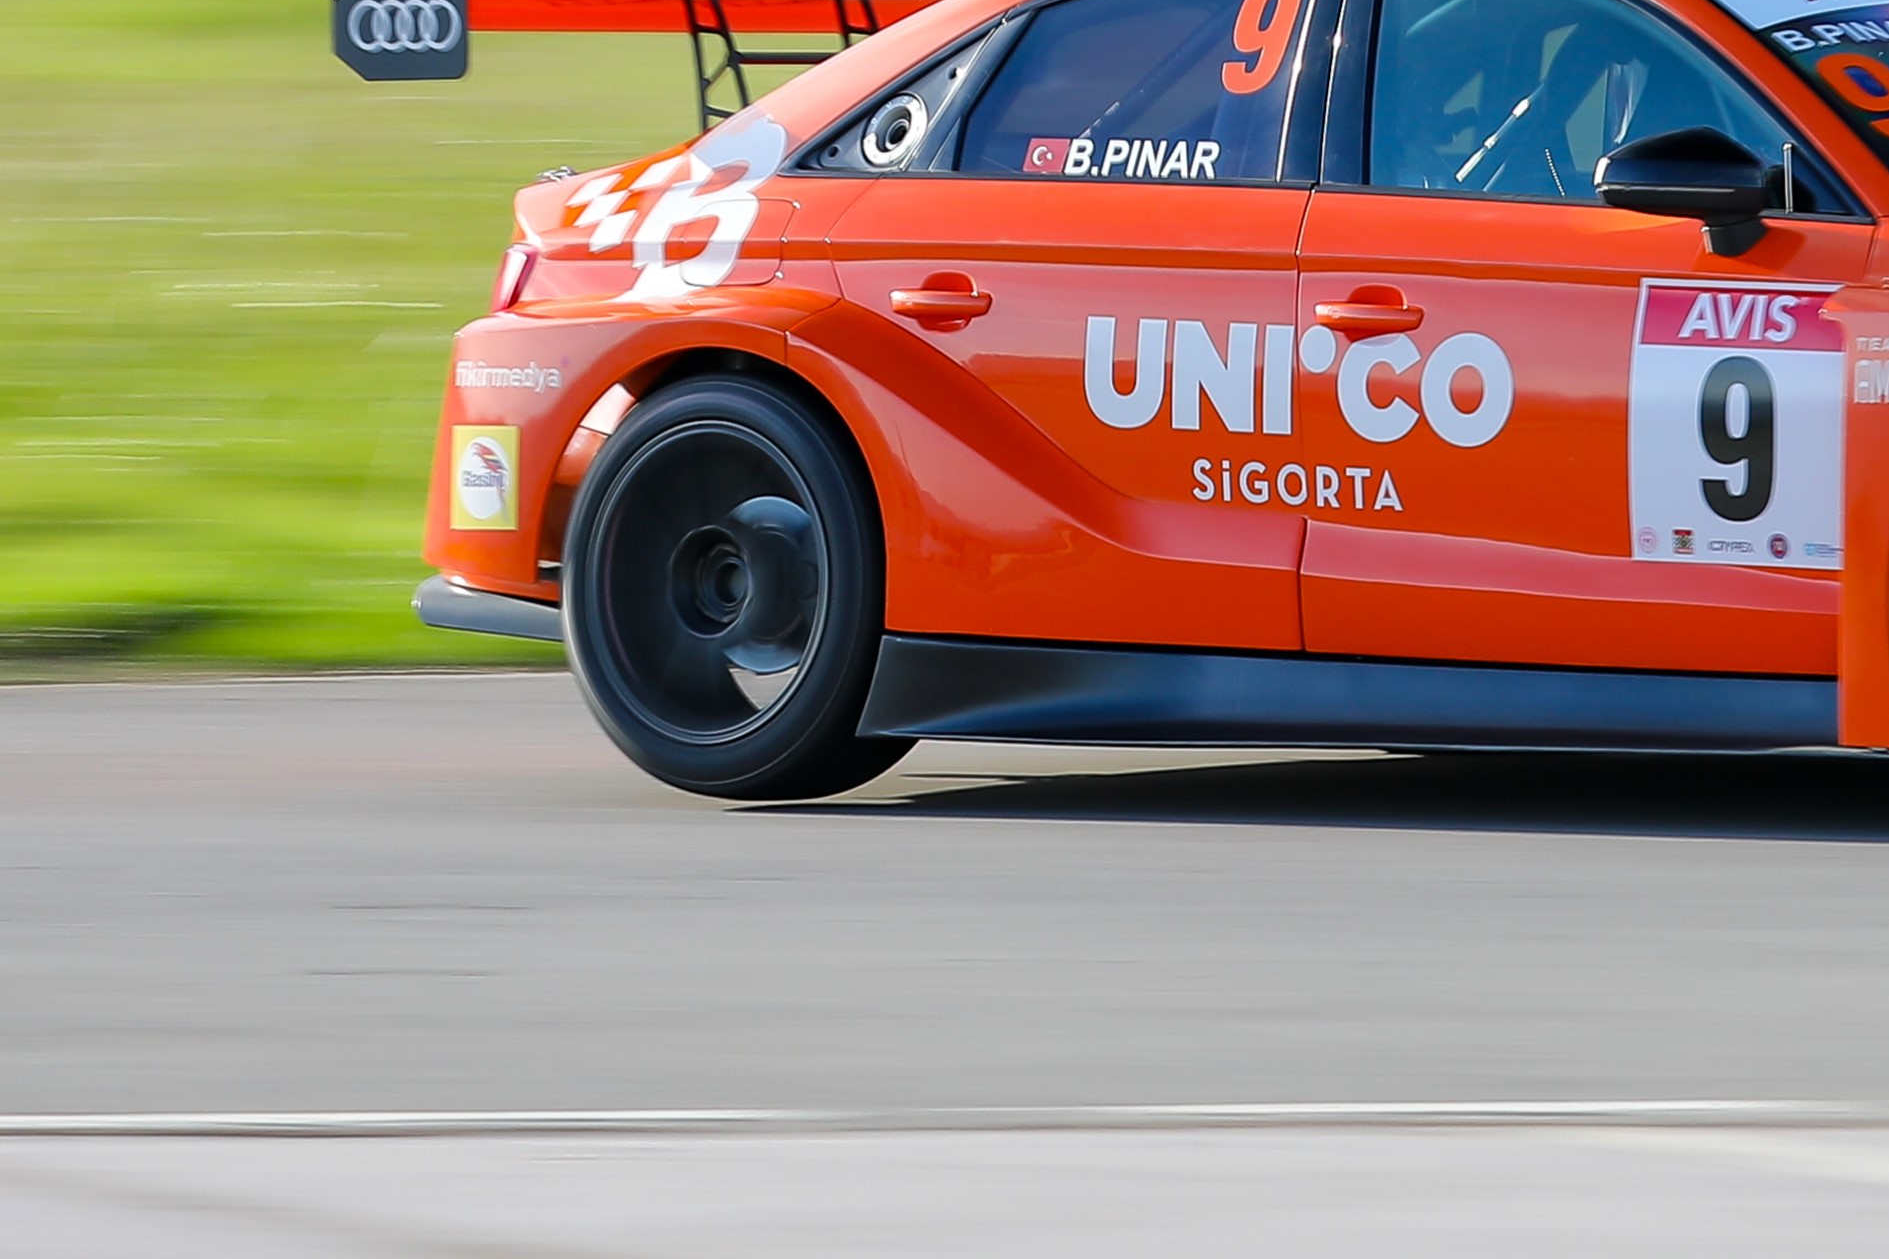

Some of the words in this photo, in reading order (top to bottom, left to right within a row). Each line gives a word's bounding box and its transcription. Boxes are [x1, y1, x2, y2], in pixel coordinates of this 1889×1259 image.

[1064, 138, 1221, 180] B.PINAR
[1678, 292, 1800, 343] AVIS
[1700, 355, 1775, 523] 9
